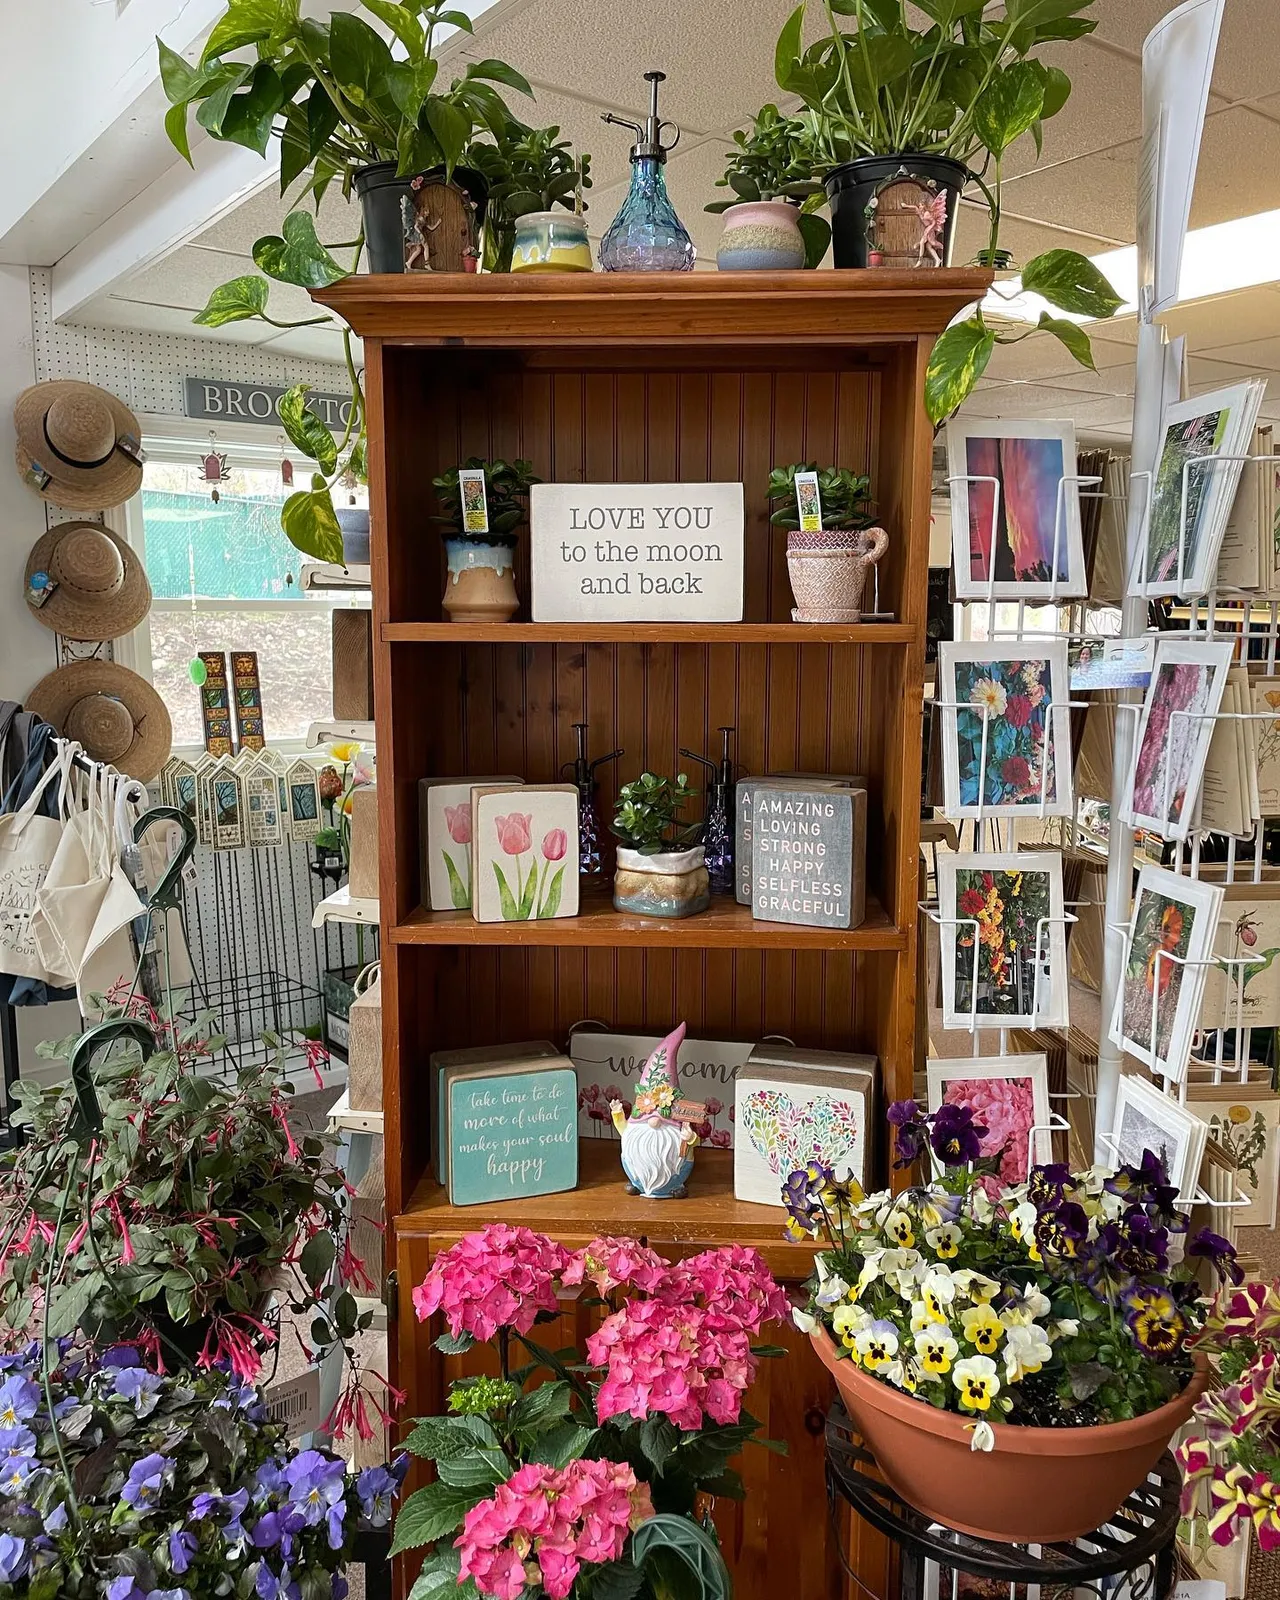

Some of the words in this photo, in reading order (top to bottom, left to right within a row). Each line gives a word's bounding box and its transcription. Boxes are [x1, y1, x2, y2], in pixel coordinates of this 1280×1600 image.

[569, 507, 645, 530] LOVE
[652, 506, 713, 529] YOU
[560, 541, 587, 562] to
[594, 540, 639, 562] the
[646, 544, 723, 562] moon
[580, 572, 631, 595] and
[637, 572, 703, 595] back
[759, 799, 834, 817] AMAZING
[761, 818, 820, 836] LOVING
[760, 838, 826, 856] STRONG
[20, 863, 35, 873] ALL
[770, 858, 824, 875] HAPPY
[759, 876, 842, 897] SELFLESS
[759, 895, 844, 917] GRACEFUL
[10, 943, 36, 955] FOUR
[468, 1090, 498, 1109] take
[501, 1088, 529, 1105] time
[532, 1085, 547, 1101] to
[548, 1083, 564, 1099] do
[464, 1115, 508, 1130] more
[512, 1109, 524, 1128] of
[527, 1105, 568, 1123] what
[459, 1136, 499, 1153] makes
[503, 1136, 534, 1157] your
[539, 1123, 573, 1146] soul
[487, 1153, 546, 1185] happy
